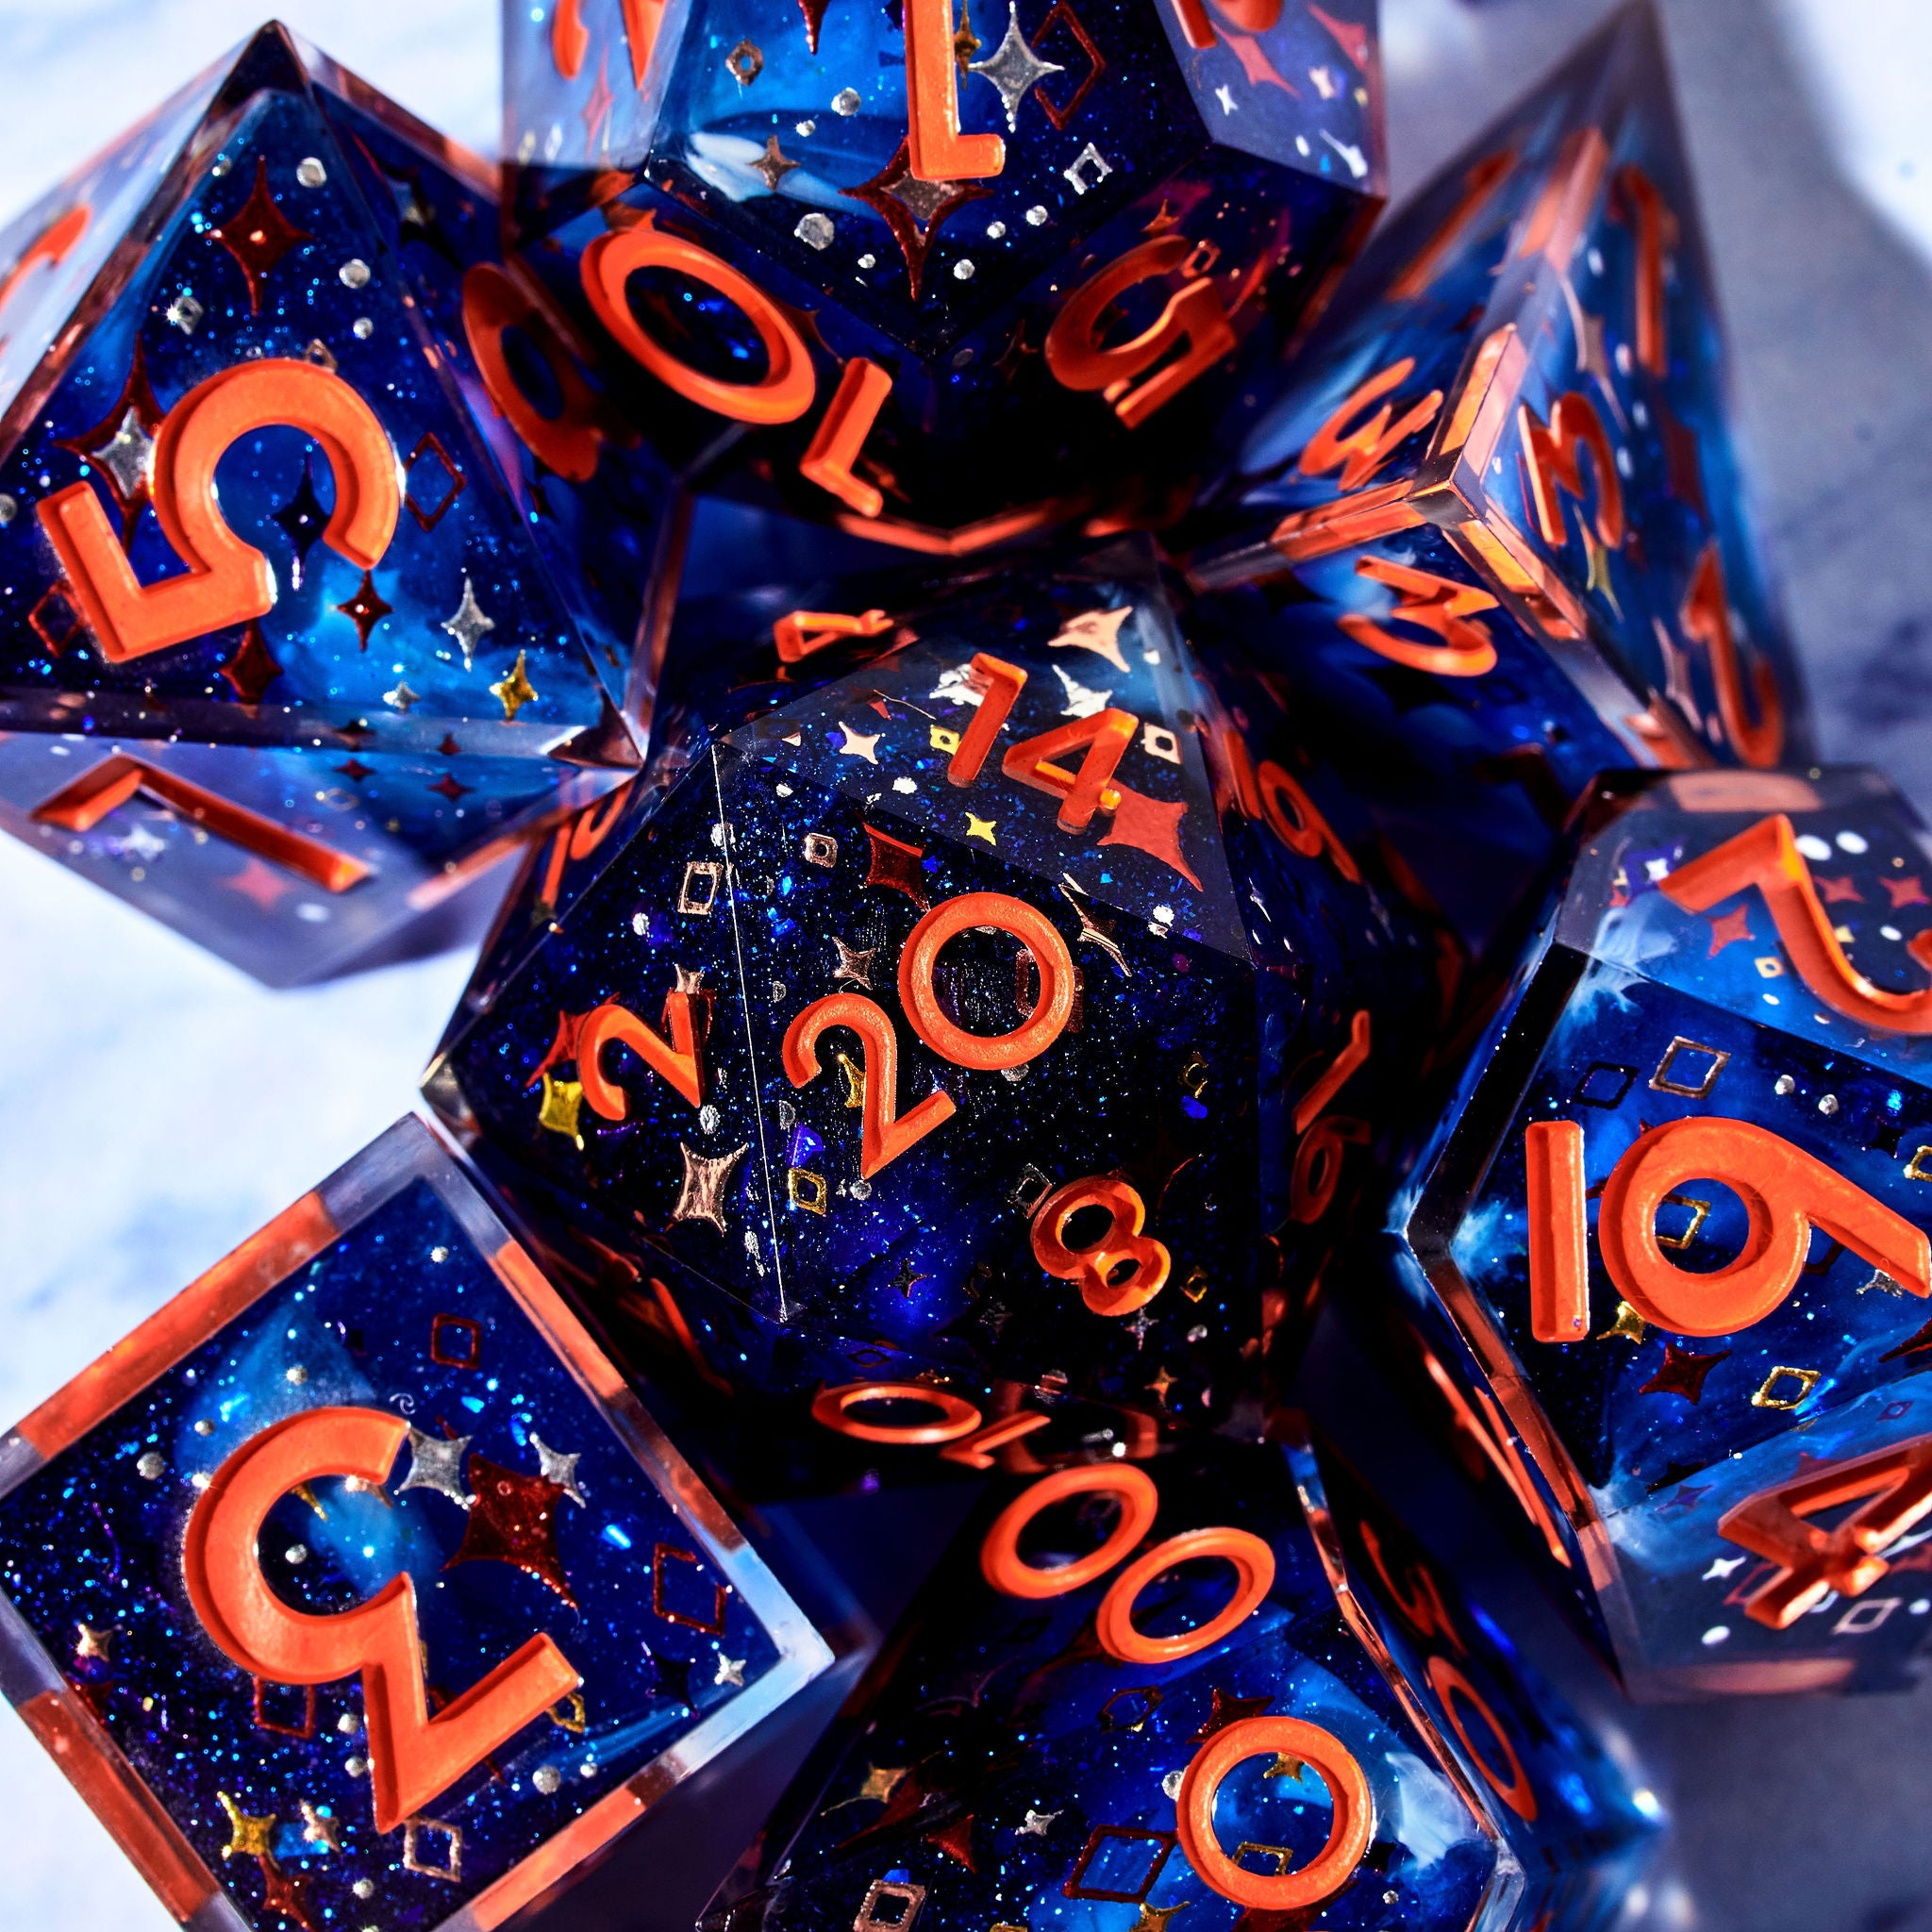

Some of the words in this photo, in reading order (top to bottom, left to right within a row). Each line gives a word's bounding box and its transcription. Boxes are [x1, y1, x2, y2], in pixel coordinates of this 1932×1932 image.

[36, 358, 401, 663] 5
[579, 228, 892, 517] 10
[947, 653, 1139, 835] 14
[576, 991, 706, 1121] 2
[782, 892, 1073, 1179] 20
[1030, 1175, 1170, 1317] 8
[183, 1406, 582, 1834] 3
